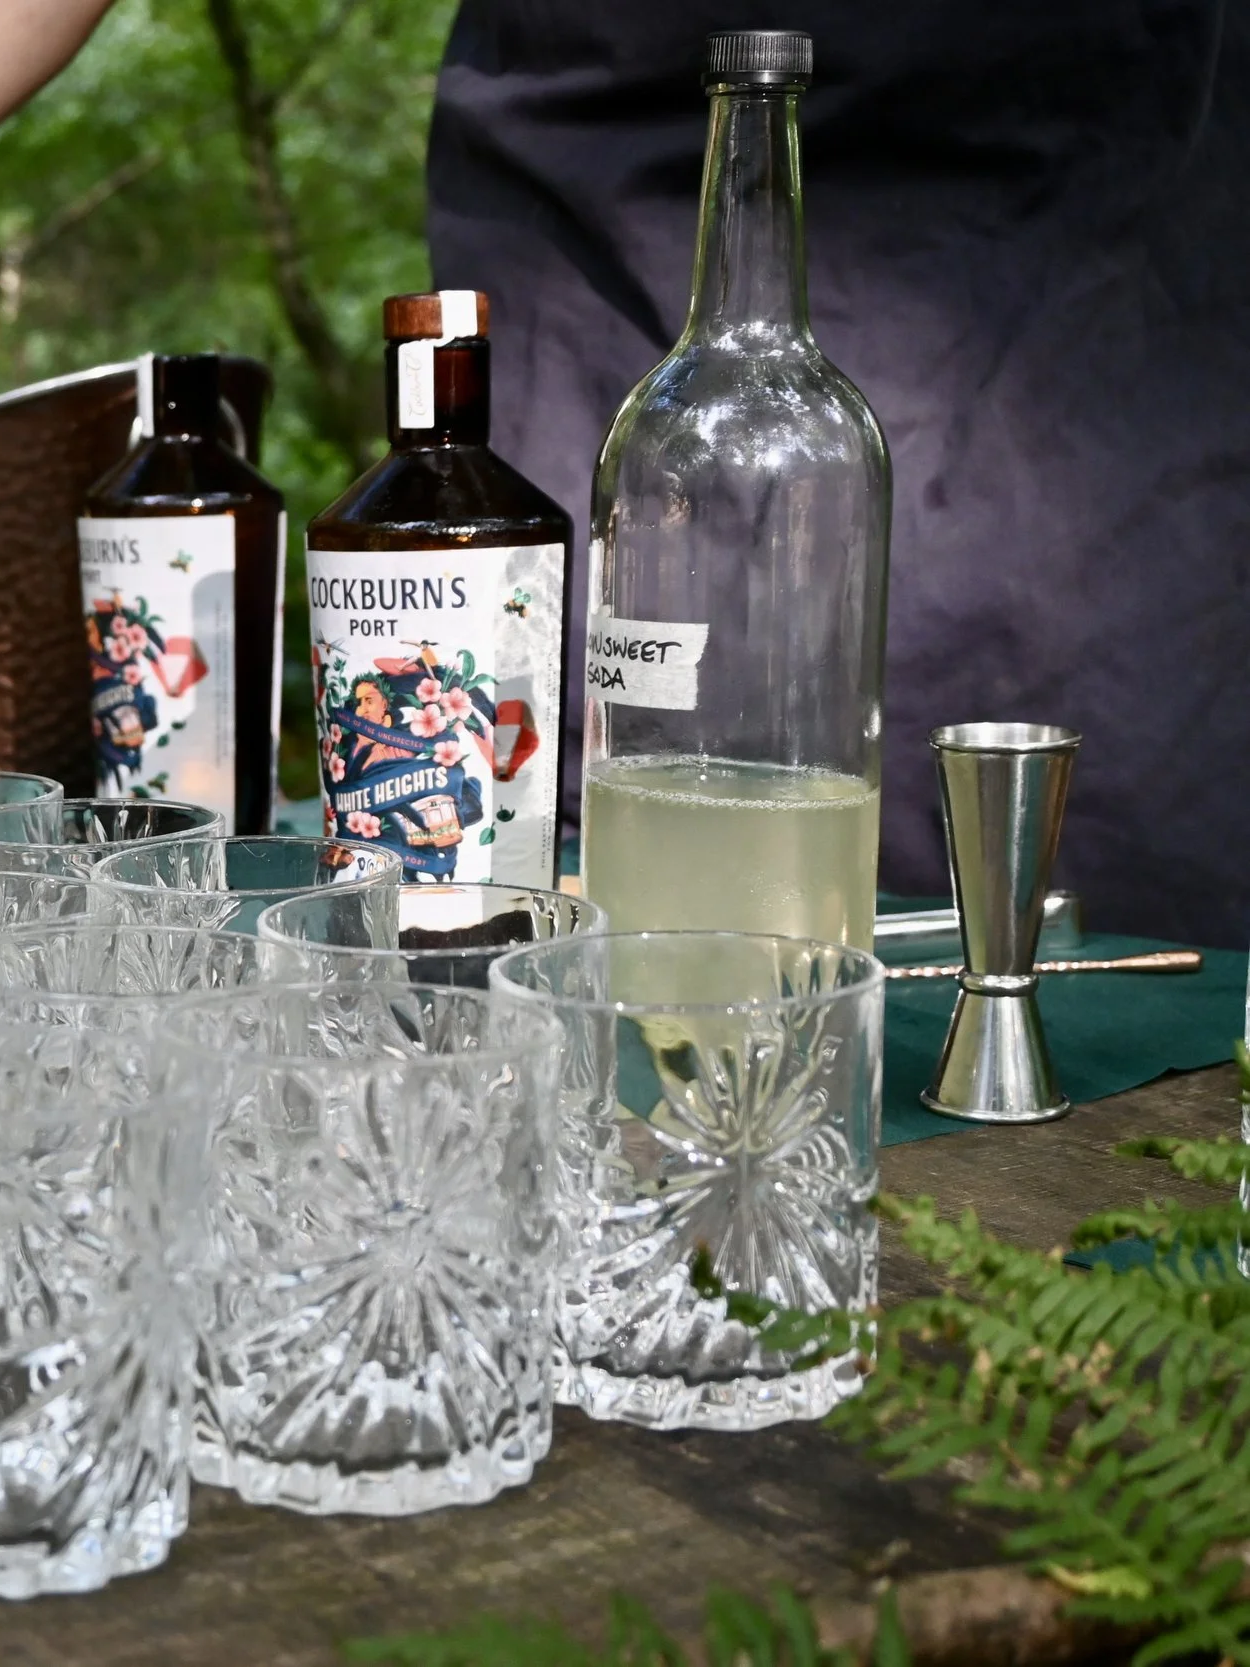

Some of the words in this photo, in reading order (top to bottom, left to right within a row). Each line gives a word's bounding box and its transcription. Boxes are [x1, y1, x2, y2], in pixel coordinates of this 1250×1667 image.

[350, 619, 398, 636] PORT
[587, 661, 626, 691] SODA
[335, 787, 372, 813] WHITE
[374, 765, 449, 805] HEIGHTS
